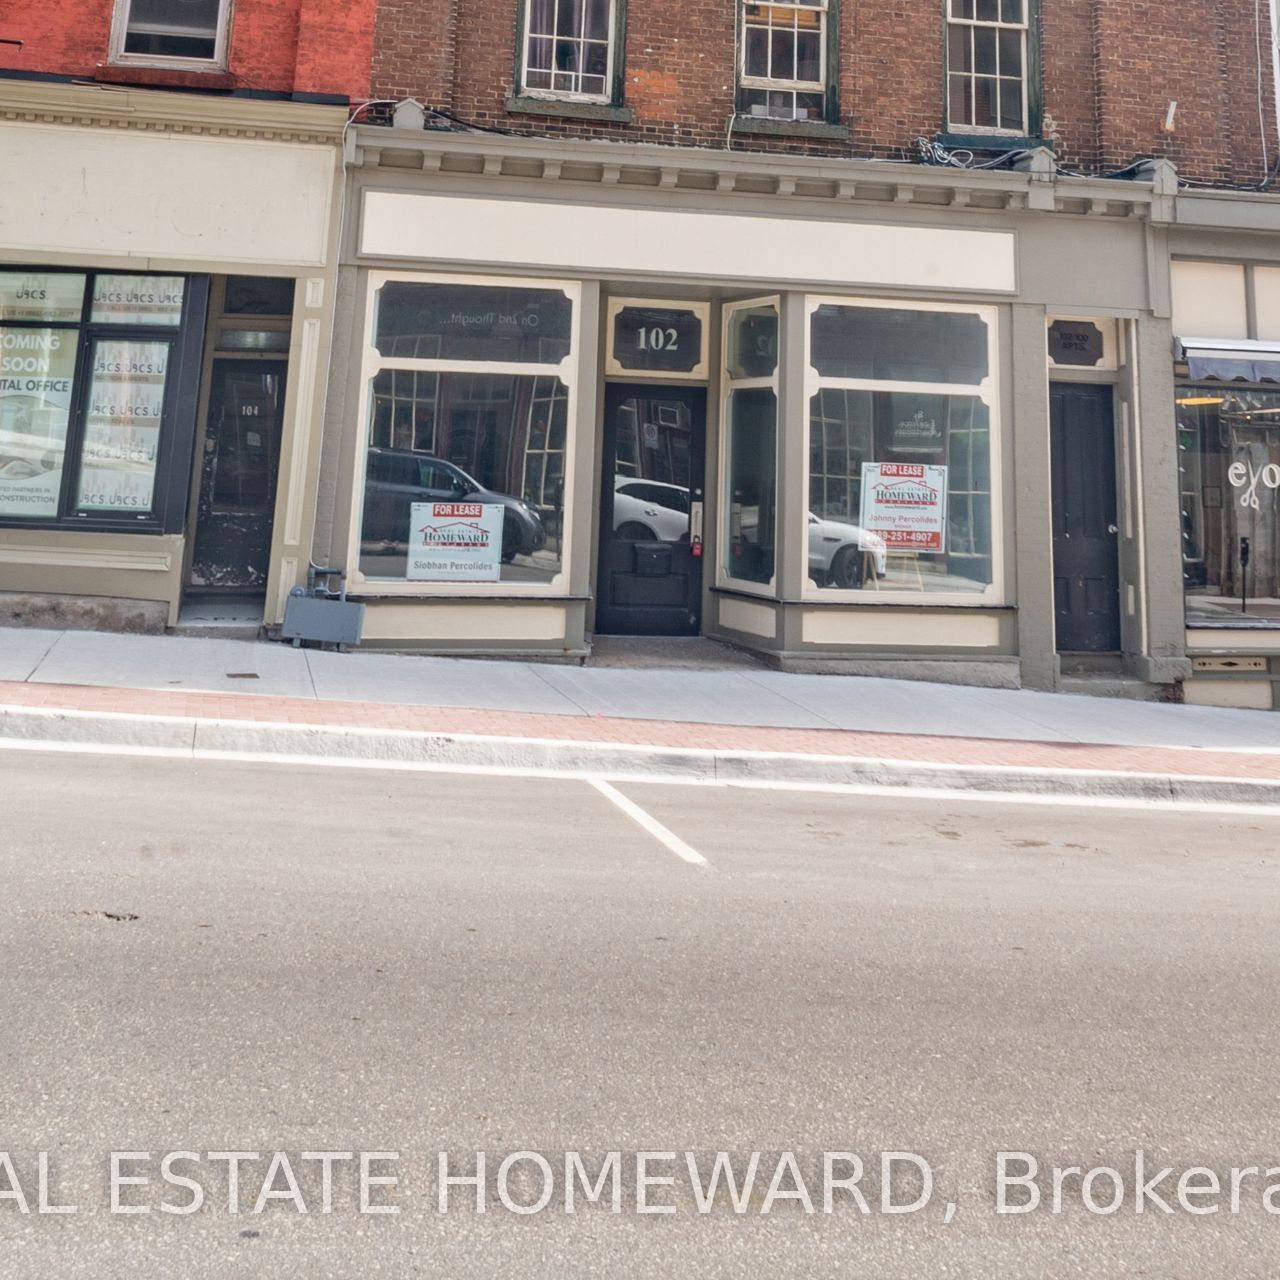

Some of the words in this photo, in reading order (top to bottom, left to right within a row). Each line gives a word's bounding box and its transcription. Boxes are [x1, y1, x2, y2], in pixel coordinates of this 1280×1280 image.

[637, 327, 679, 351] 102
[1, 357, 50, 372] SOON
[25, 380, 70, 392] OFFICE
[241, 406, 259, 416] 104
[882, 464, 897, 474] FOR
[899, 465, 923, 476] LEASE
[876, 489, 937, 501] HOMEWARD
[434, 505, 452, 515] FOR
[454, 505, 481, 516] LEASE
[869, 514, 897, 523] Johnny
[898, 514, 938, 524] Percolides
[424, 532, 489, 542] HOMEWARD
[872, 530, 932, 542] 89-251-4907
[414, 561, 448, 570] Siobhan
[450, 561, 493, 571] Percolides
